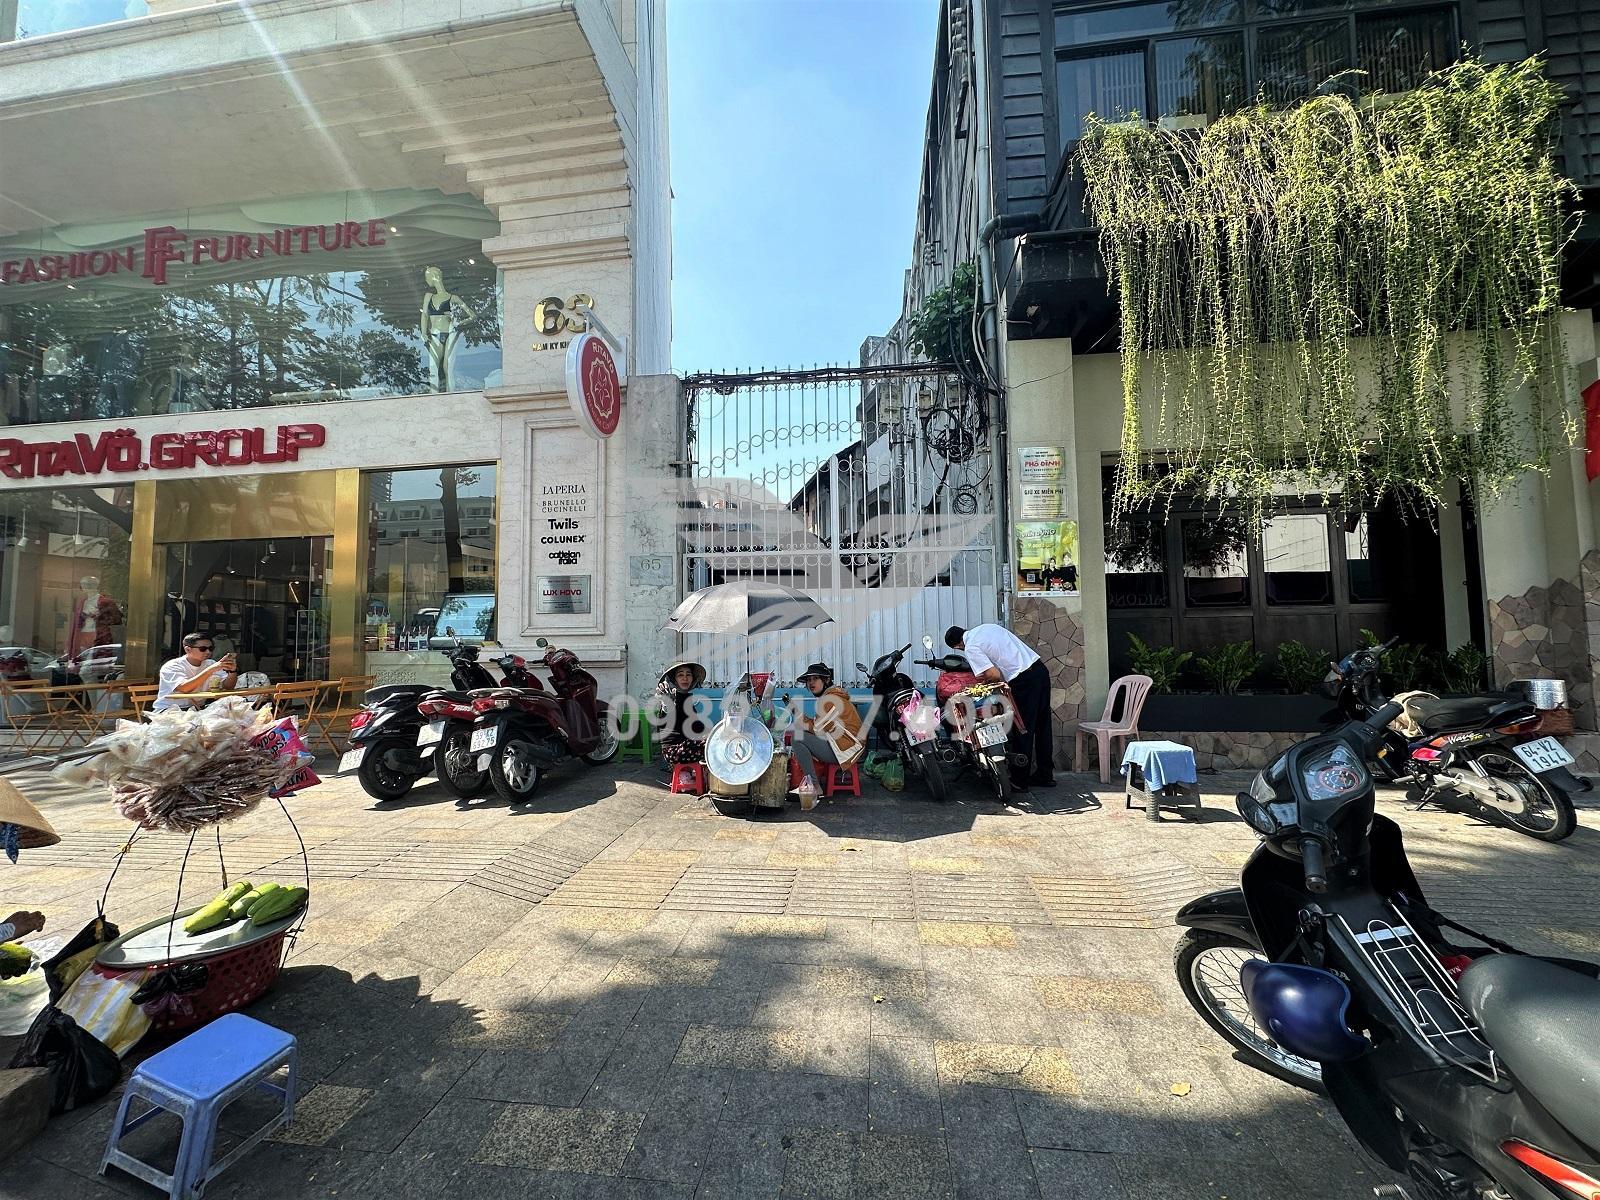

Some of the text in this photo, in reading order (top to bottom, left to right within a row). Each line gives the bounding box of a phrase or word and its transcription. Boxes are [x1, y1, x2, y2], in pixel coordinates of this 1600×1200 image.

[1, 246, 134, 286] FASHION
[192, 218, 386, 265] FURNITURE
[534, 293, 595, 336] 63
[542, 499, 586, 507] BRUNELLO
[548, 518, 579, 530] Twils
[540, 535, 585, 544] COLUNEX
[640, 558, 661, 571] 65
[1532, 752, 1567, 769] 1944
